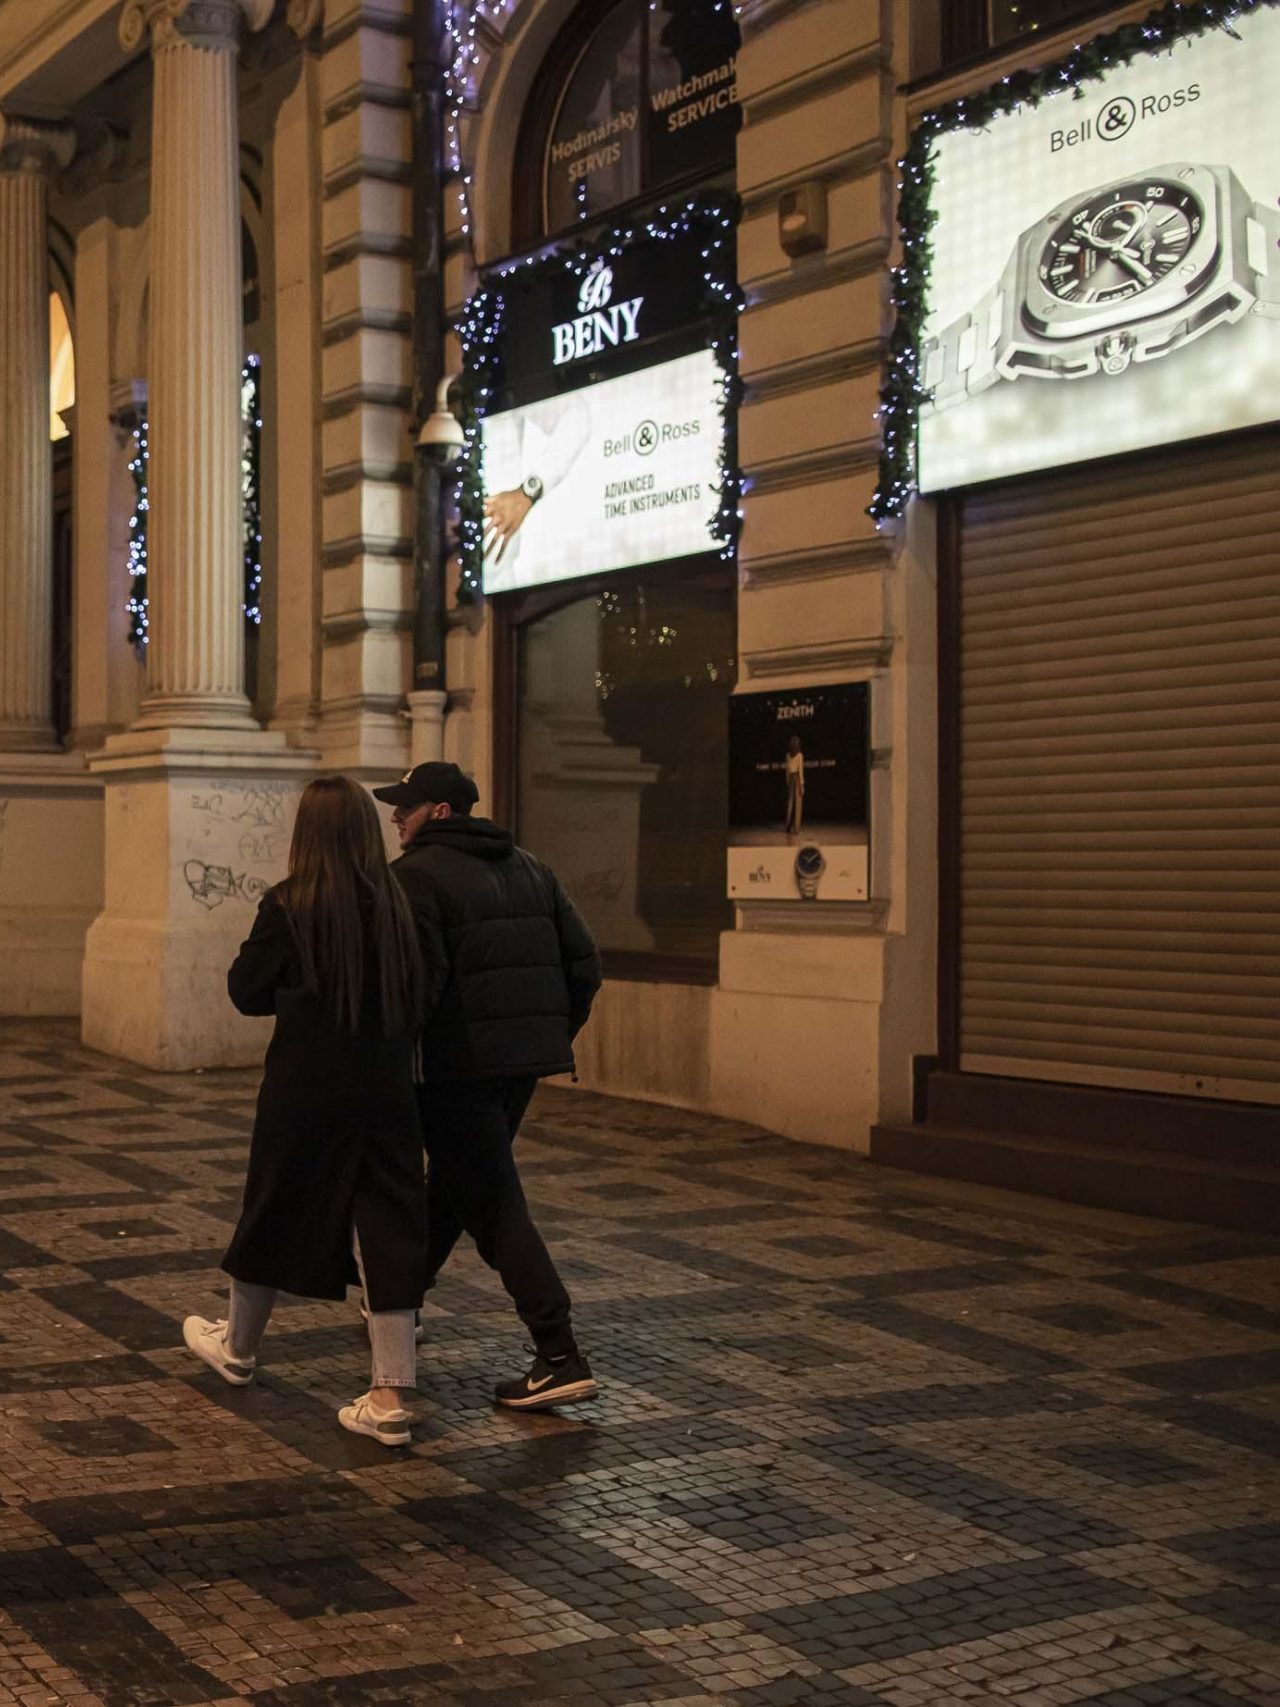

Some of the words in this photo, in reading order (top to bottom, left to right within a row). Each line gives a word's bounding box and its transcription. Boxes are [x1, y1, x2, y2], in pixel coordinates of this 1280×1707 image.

[1050, 119, 1092, 153] Bell
[1140, 83, 1201, 120] Ross
[568, 142, 621, 183] SERVIS
[551, 296, 645, 366] BENY
[603, 434, 631, 458] Bell
[661, 419, 700, 443] Ross
[604, 474, 655, 499] ADVANCED
[604, 500, 626, 520] TIME
[629, 483, 701, 515] INSTRUMENTS
[776, 704, 815, 720] ZENITH
